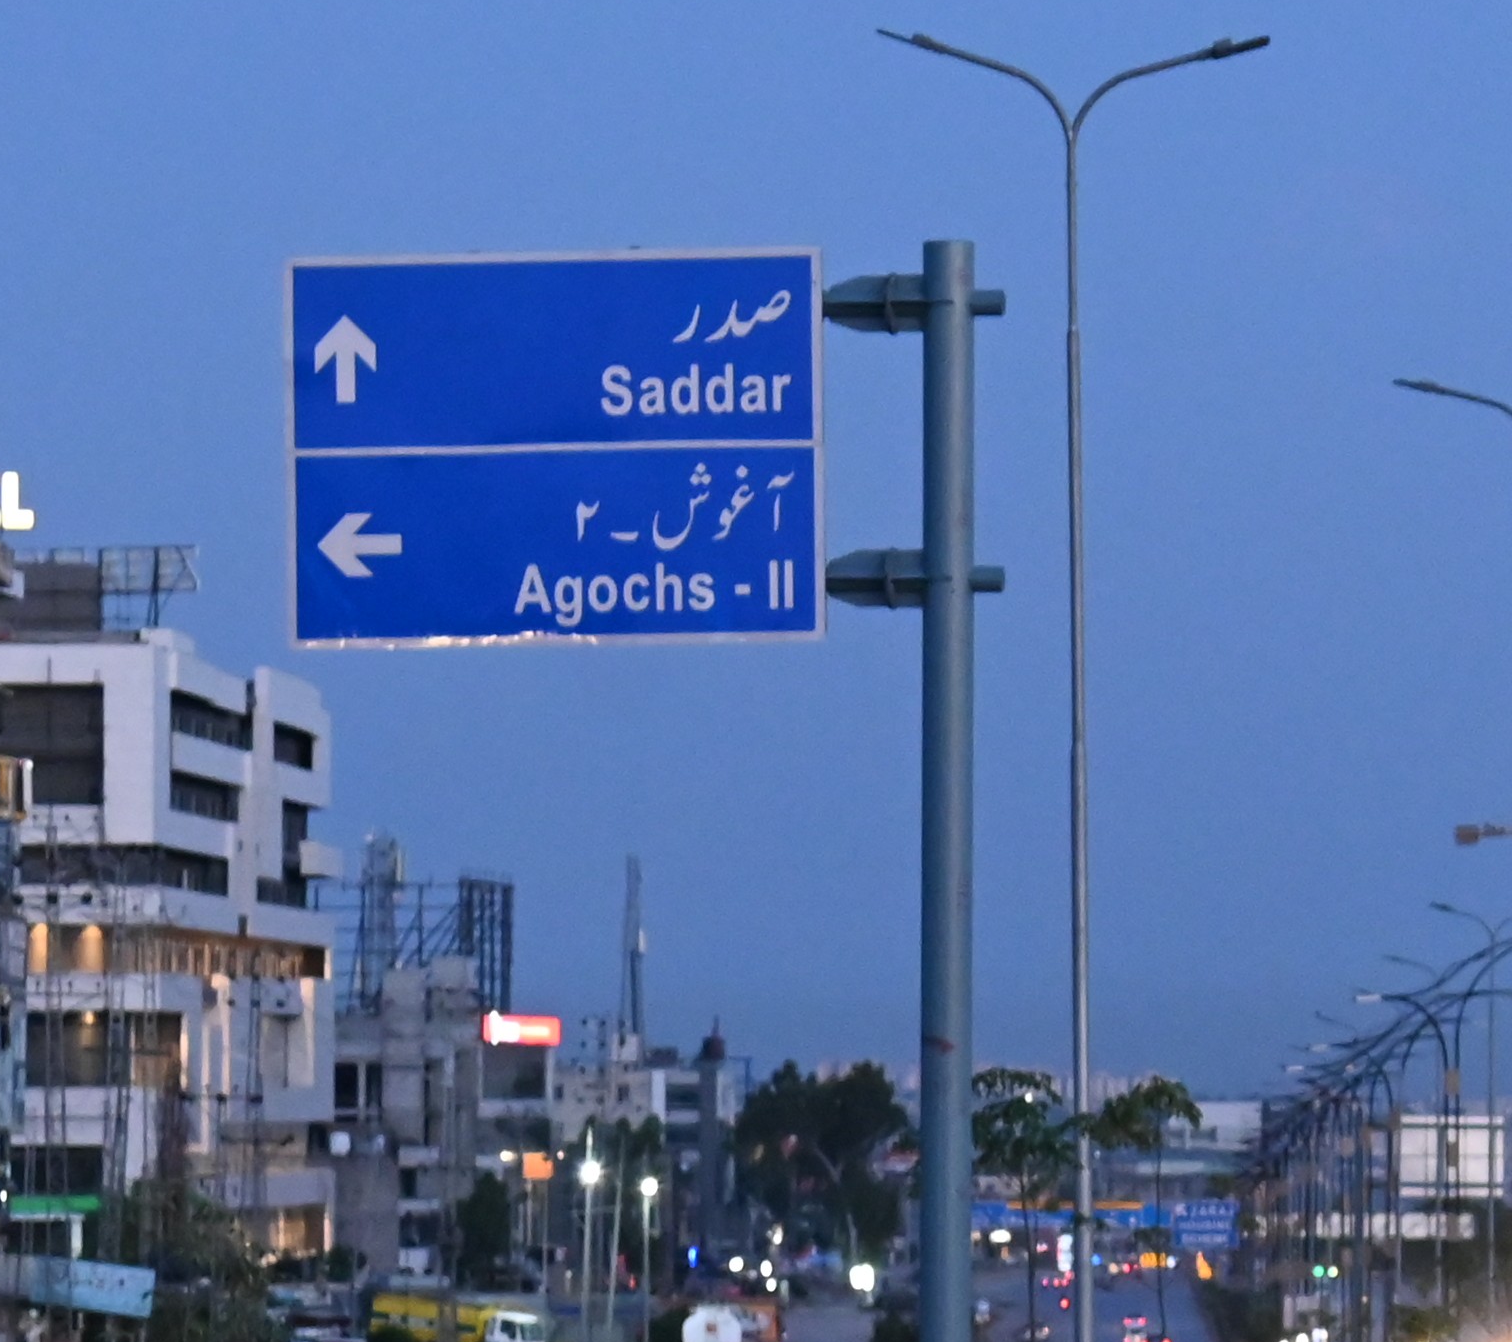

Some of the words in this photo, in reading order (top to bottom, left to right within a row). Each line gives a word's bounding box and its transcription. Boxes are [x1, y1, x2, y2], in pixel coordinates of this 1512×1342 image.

[672, 288, 793, 344] صدر
[600, 363, 792, 417] Saddar
[652, 462, 795, 551] آغوش
[514, 562, 717, 628] Agochs
